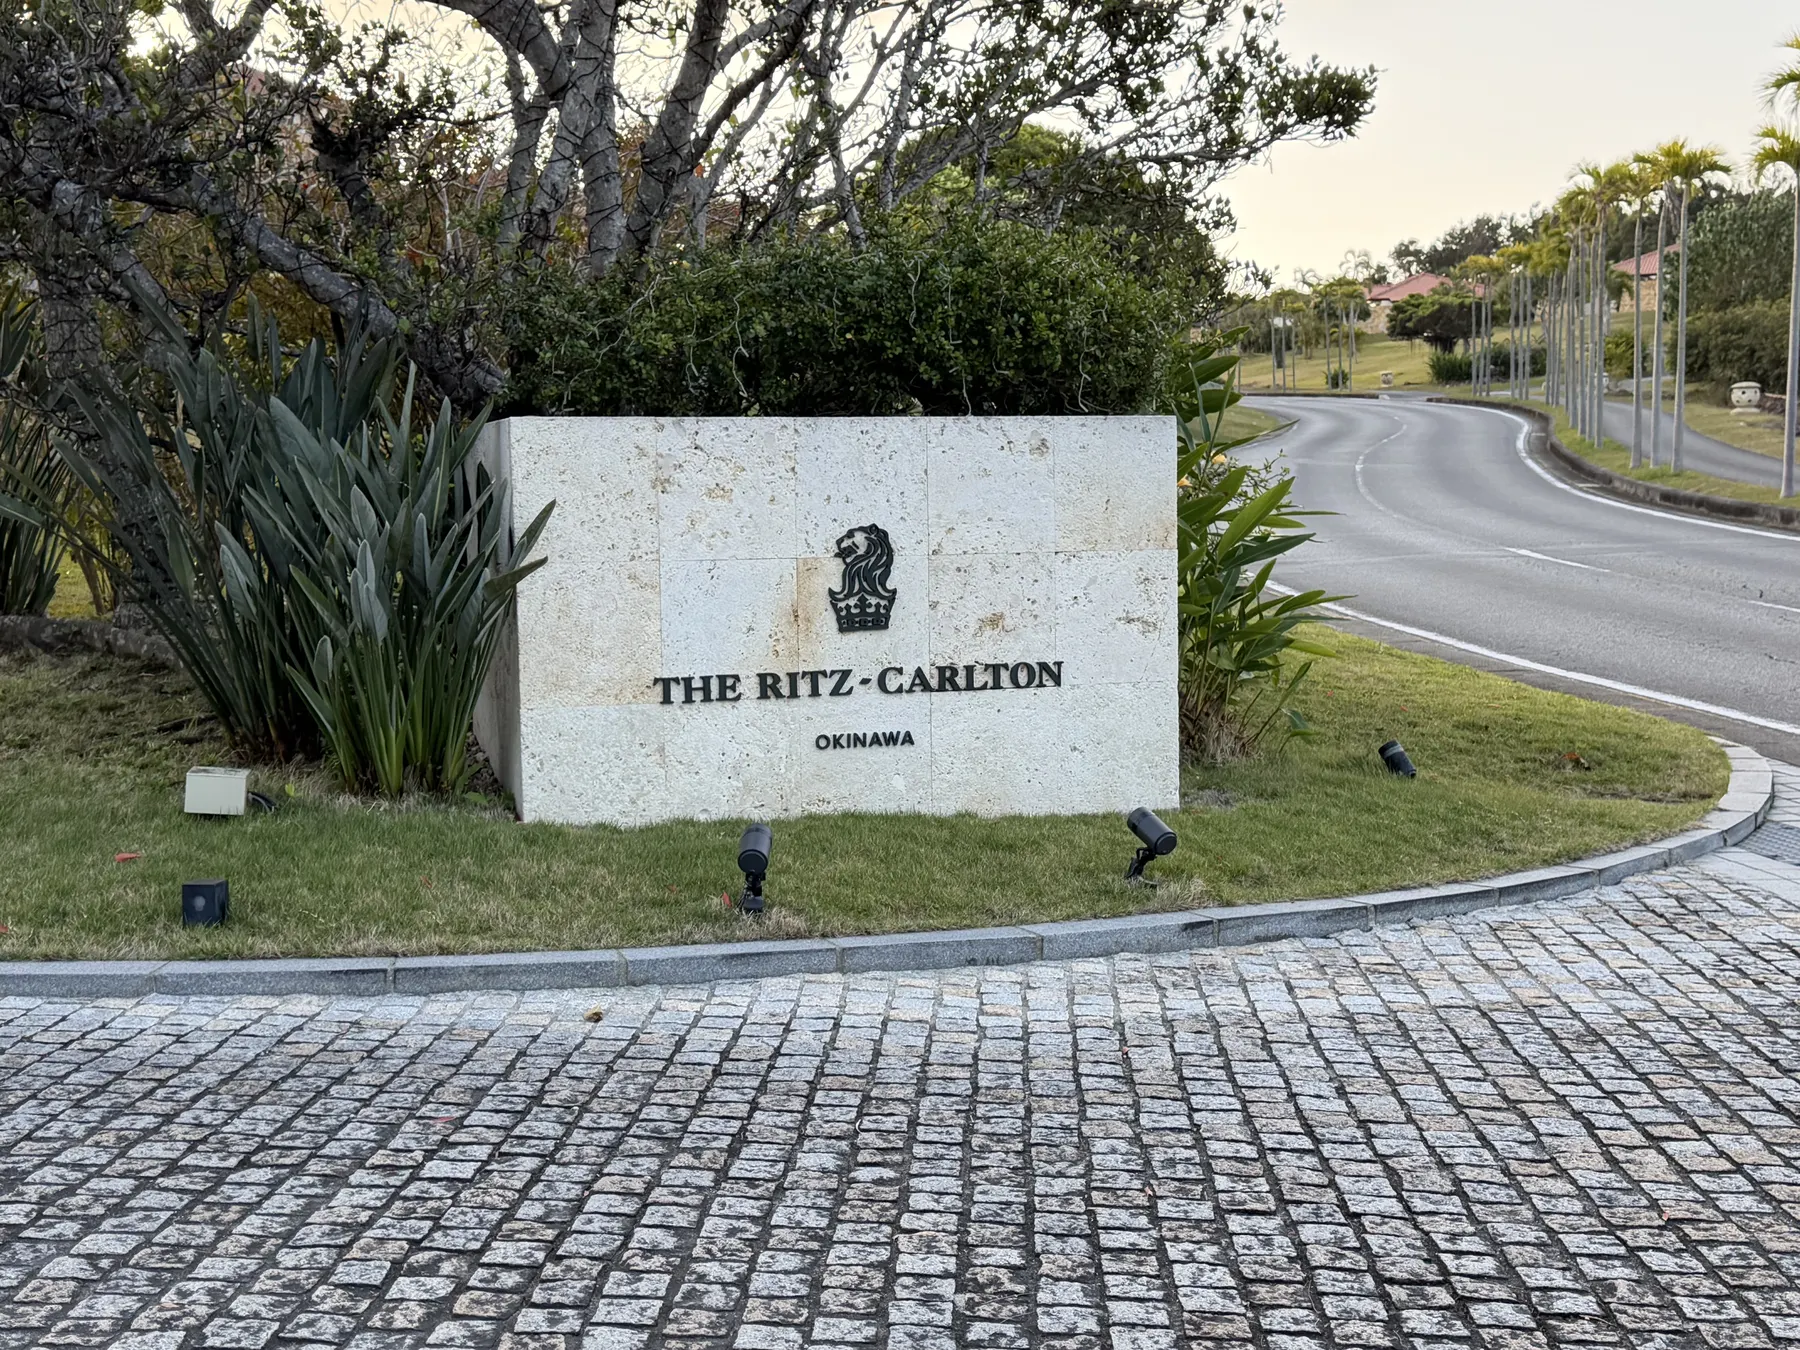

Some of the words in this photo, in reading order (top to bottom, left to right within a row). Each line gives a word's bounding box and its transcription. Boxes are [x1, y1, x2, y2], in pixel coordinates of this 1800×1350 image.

[653, 675, 742, 705] THE
[756, 661, 1065, 700] RITZ-CARLTON
[815, 730, 915, 750] OKINAWA
